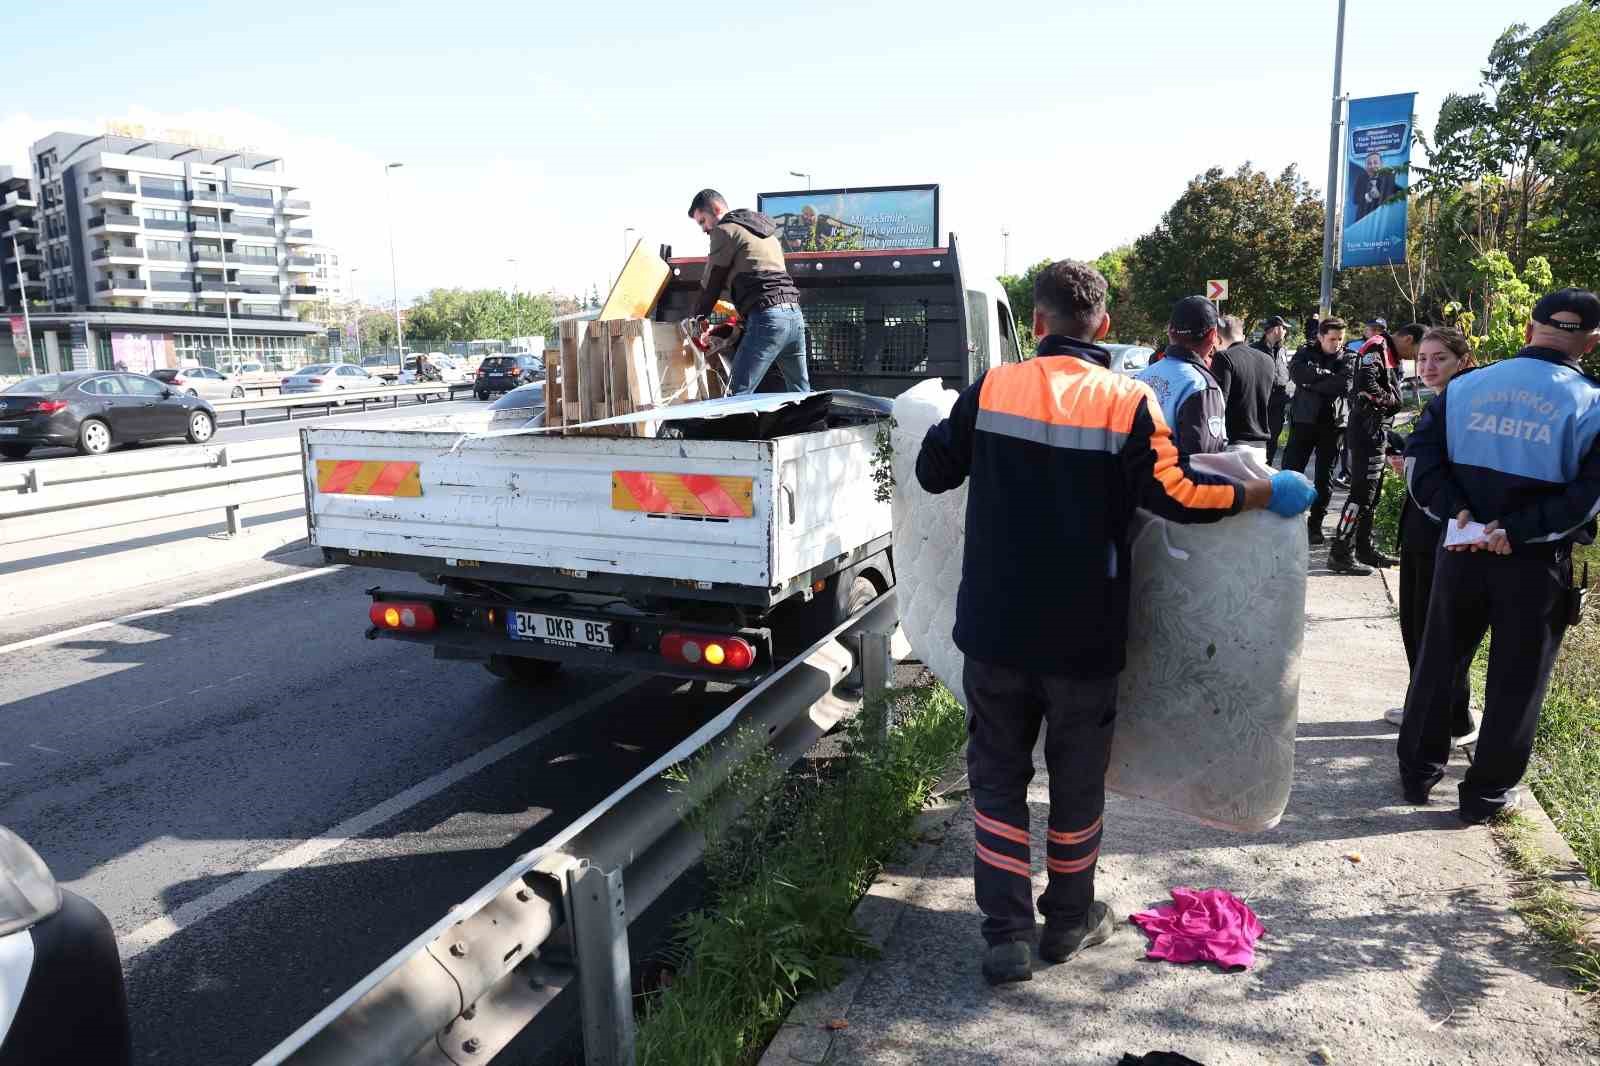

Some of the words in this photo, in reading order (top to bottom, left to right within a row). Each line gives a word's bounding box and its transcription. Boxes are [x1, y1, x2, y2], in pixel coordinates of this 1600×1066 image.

[1466, 412, 1552, 445] ZABITA
[517, 614, 536, 635] 34
[545, 617, 575, 639] DKR
